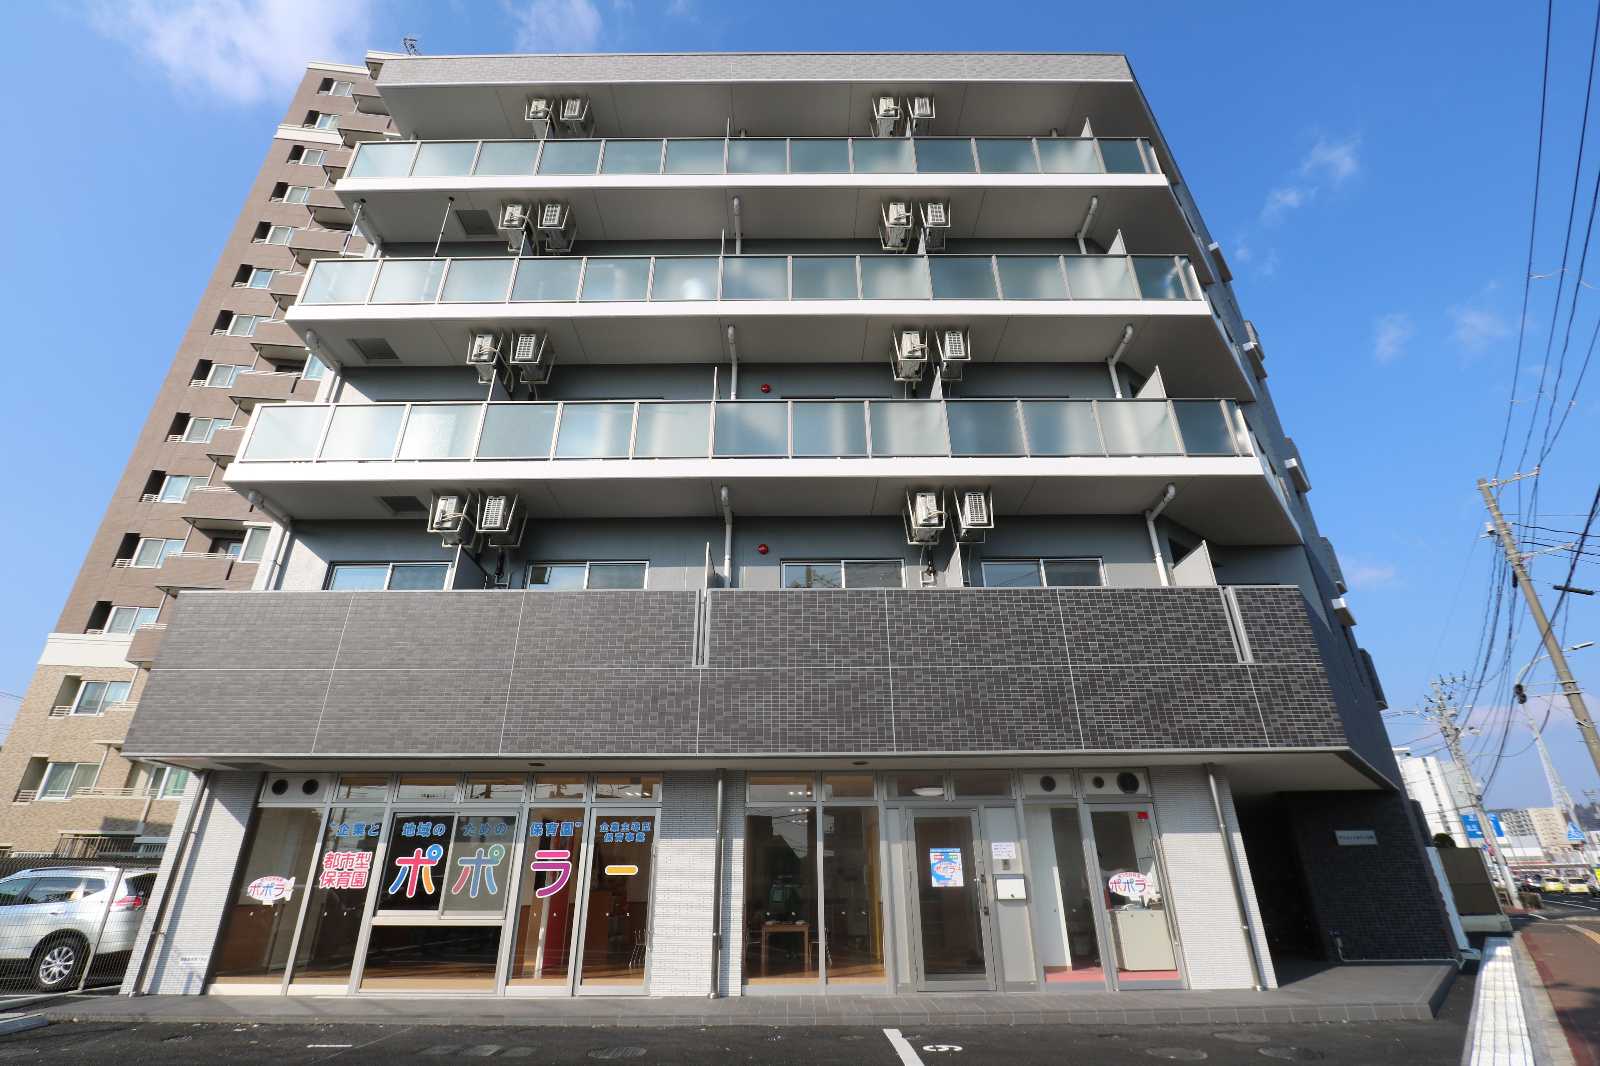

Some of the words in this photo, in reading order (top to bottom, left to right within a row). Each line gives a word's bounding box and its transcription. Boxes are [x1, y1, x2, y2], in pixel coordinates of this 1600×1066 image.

[323, 850, 373, 870] 都市型
[319, 870, 368, 890] 保育園
